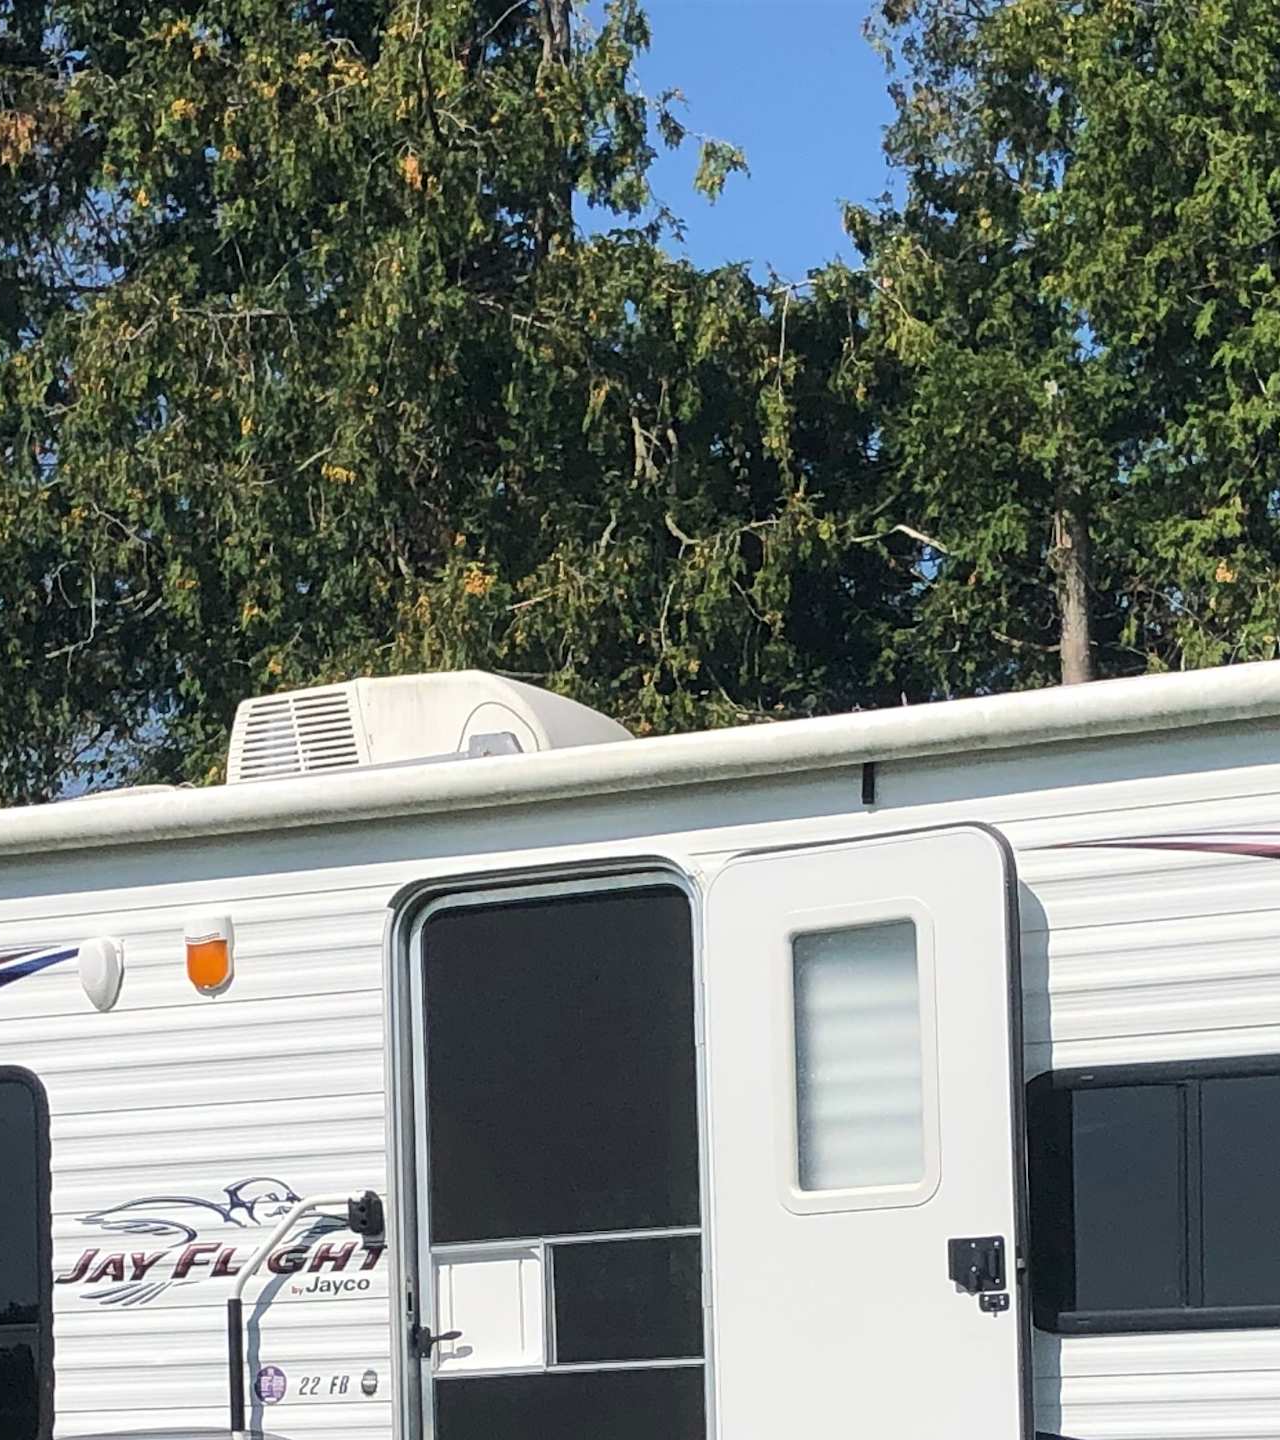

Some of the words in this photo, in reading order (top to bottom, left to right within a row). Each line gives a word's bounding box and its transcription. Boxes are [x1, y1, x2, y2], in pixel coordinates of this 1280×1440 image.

[54, 1248, 170, 1284] JAY
[291, 1285, 304, 1296] by
[305, 1275, 370, 1296] Jayco
[298, 1376, 321, 1396] 22
[329, 1374, 350, 1395] FB
